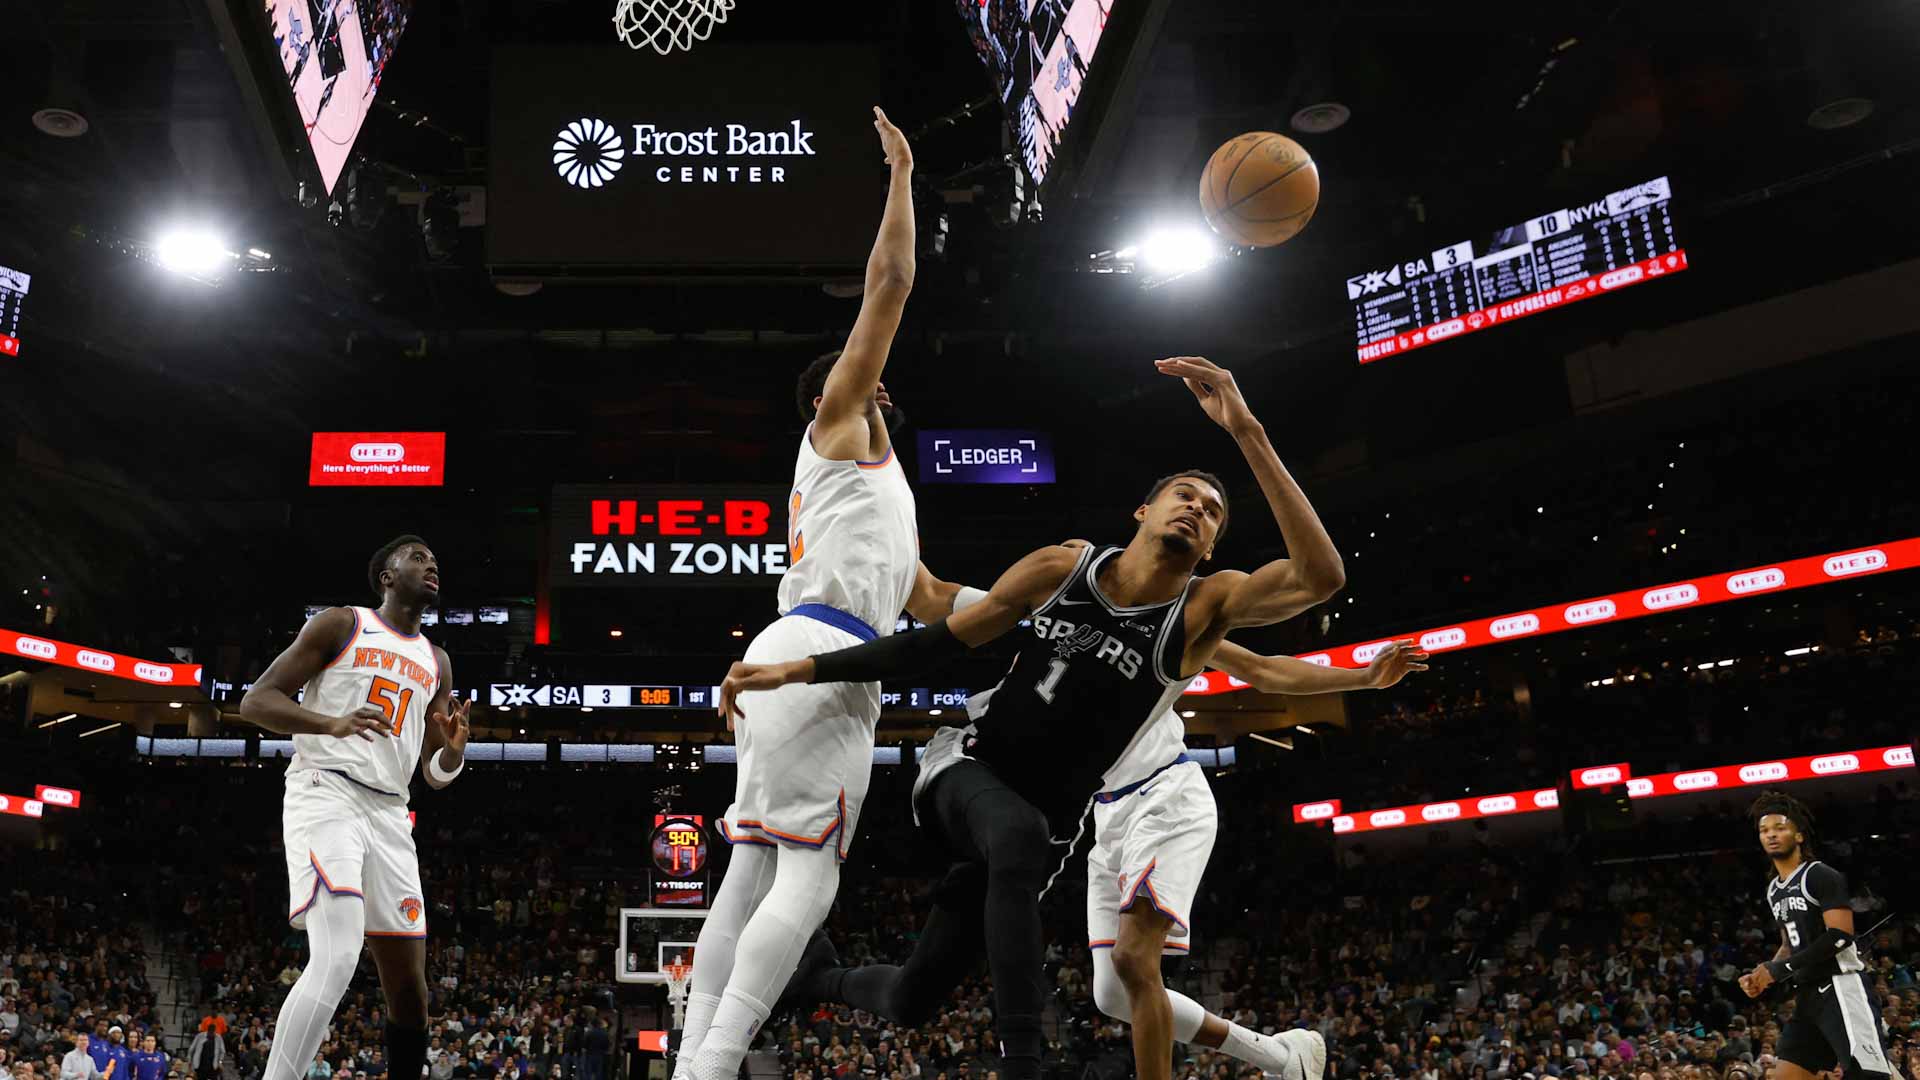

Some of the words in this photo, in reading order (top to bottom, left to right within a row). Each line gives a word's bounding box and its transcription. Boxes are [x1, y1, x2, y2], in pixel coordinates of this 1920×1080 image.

[631, 123, 718, 155] Frost
[726, 119, 815, 155] Bank
[656, 166, 785, 182] CENTER
[1539, 215, 1558, 235] 10
[1569, 200, 1608, 225] NYK
[1404, 258, 1428, 278] SA
[1446, 248, 1457, 265] 3
[323, 464, 344, 473] Here
[345, 464, 400, 475] Everything's
[401, 464, 431, 473] Better
[949, 448, 1022, 465] LEDGER
[591, 499, 771, 537] H-E-B
[570, 542, 655, 573] FAN
[669, 542, 788, 574] ZONE
[1034, 615, 1144, 681] SPURS
[353, 647, 397, 671] NEW
[398, 655, 434, 694] YORK
[1034, 656, 1070, 705] 1
[367, 674, 414, 738] 51
[552, 686, 581, 705] SA
[602, 688, 611, 704] 3
[640, 689, 671, 704] 9:05
[689, 691, 705, 703] 1ST
[882, 693, 901, 705] PF
[911, 692, 918, 706] 2
[933, 693, 967, 705] FG%
[668, 831, 699, 846] 9:04
[673, 845, 696, 871] 17
[668, 881, 704, 890] TISSOT
[1784, 921, 1800, 947] 5
